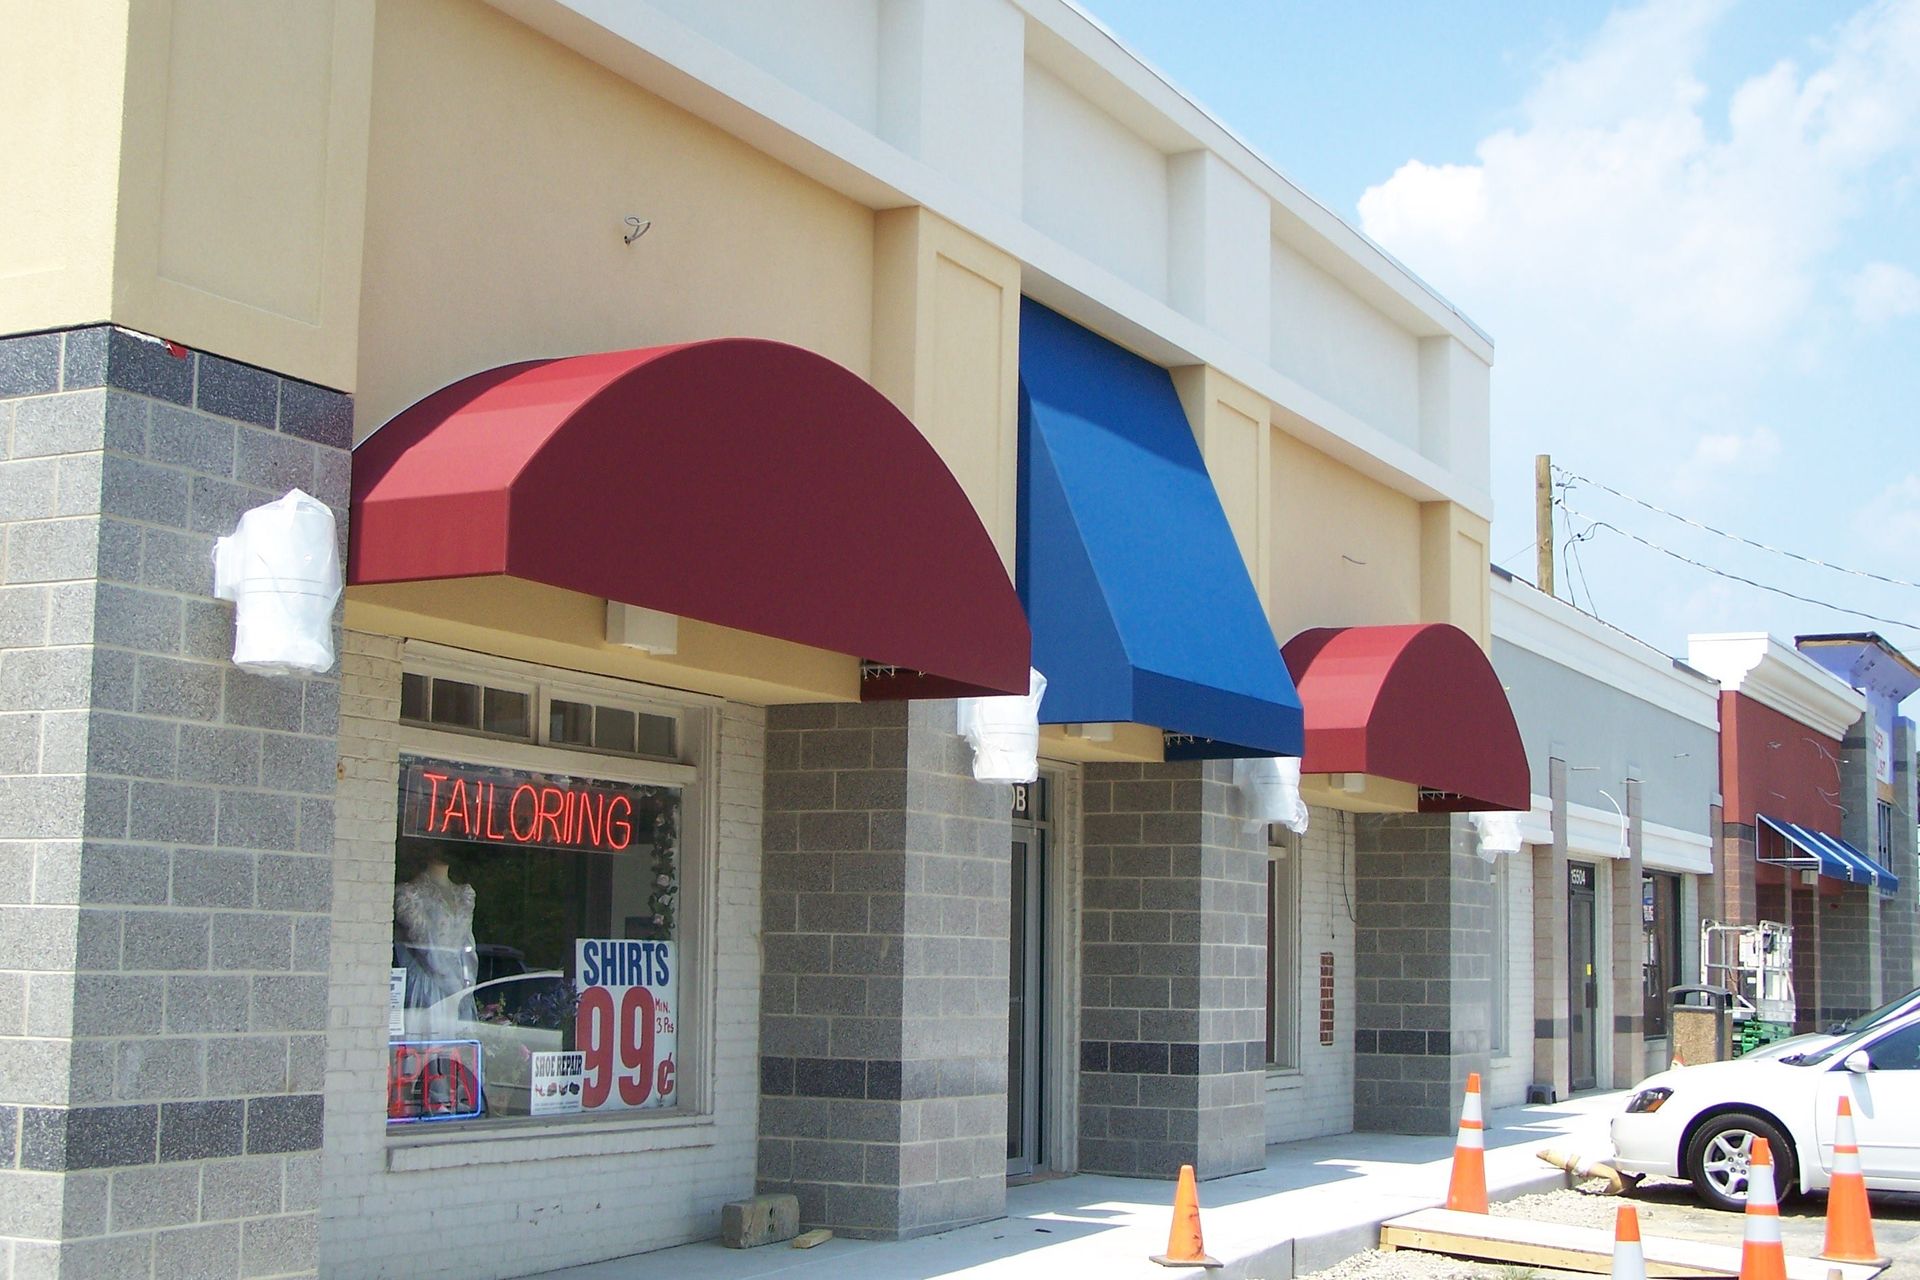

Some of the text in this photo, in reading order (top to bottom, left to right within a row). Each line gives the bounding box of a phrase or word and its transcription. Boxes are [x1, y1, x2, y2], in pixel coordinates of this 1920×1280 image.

[422, 771, 632, 850] TAILORING
[583, 940, 670, 987] SHIRTS
[655, 1017, 663, 1034] 3
[387, 1046, 477, 1117] PEN
[535, 1054, 583, 1077] SHOE REPAIR
